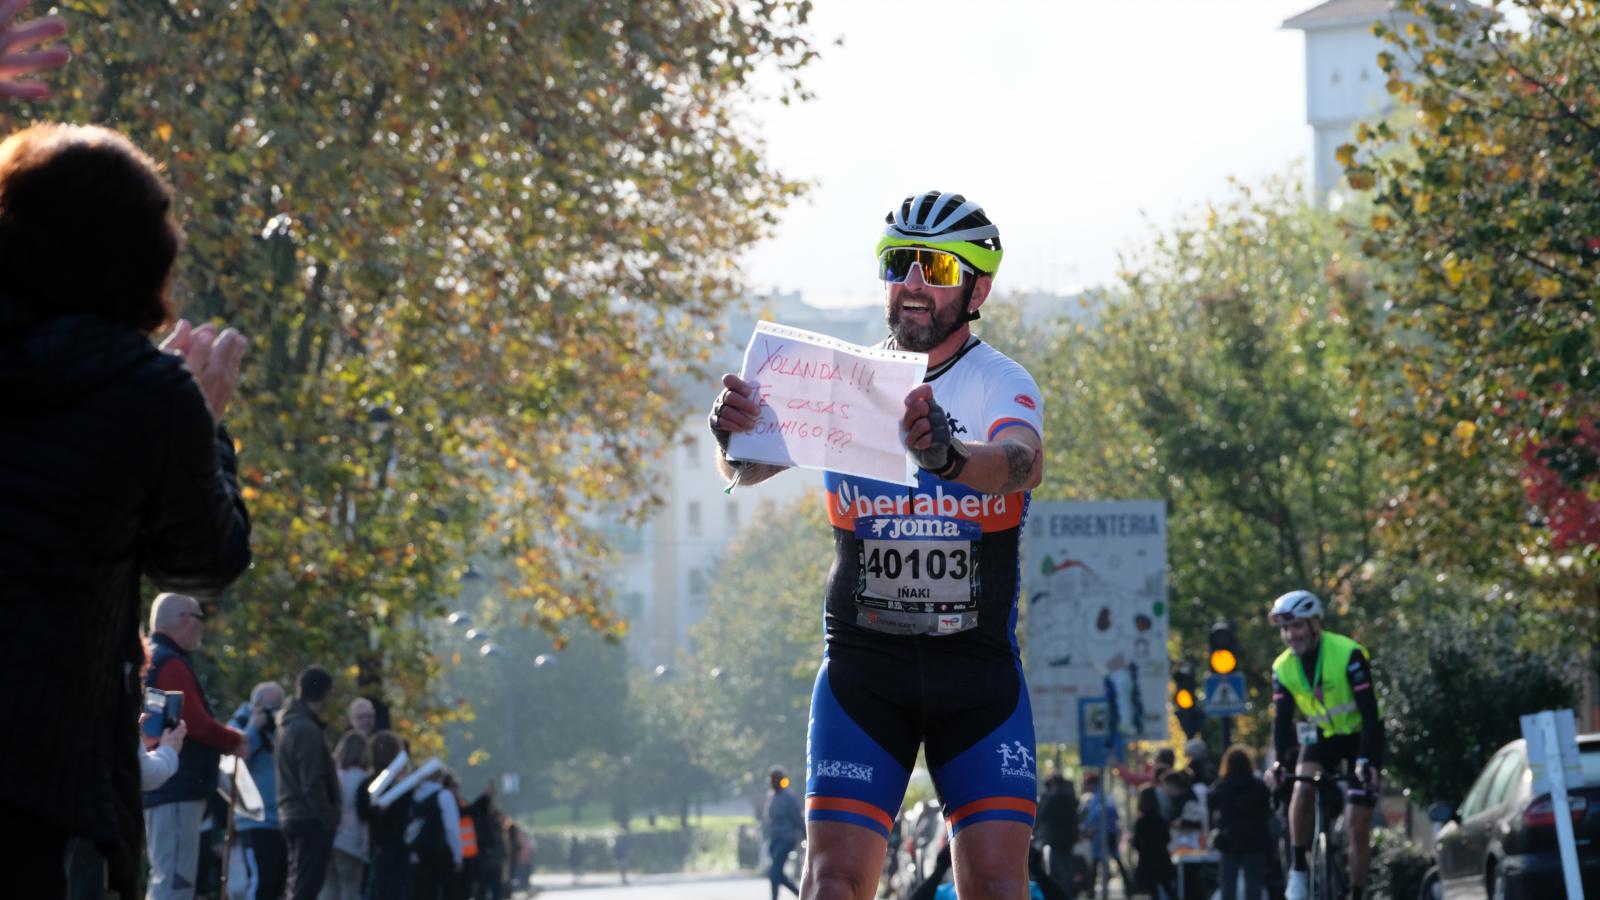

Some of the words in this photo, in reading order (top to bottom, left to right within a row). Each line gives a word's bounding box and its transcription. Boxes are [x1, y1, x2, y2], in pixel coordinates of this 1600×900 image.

[787, 398, 850, 420] CASAS
[1050, 513, 1160, 538] ERRENTERIA
[867, 548, 969, 580] 40103
[897, 585, 931, 599] IÑAKI
